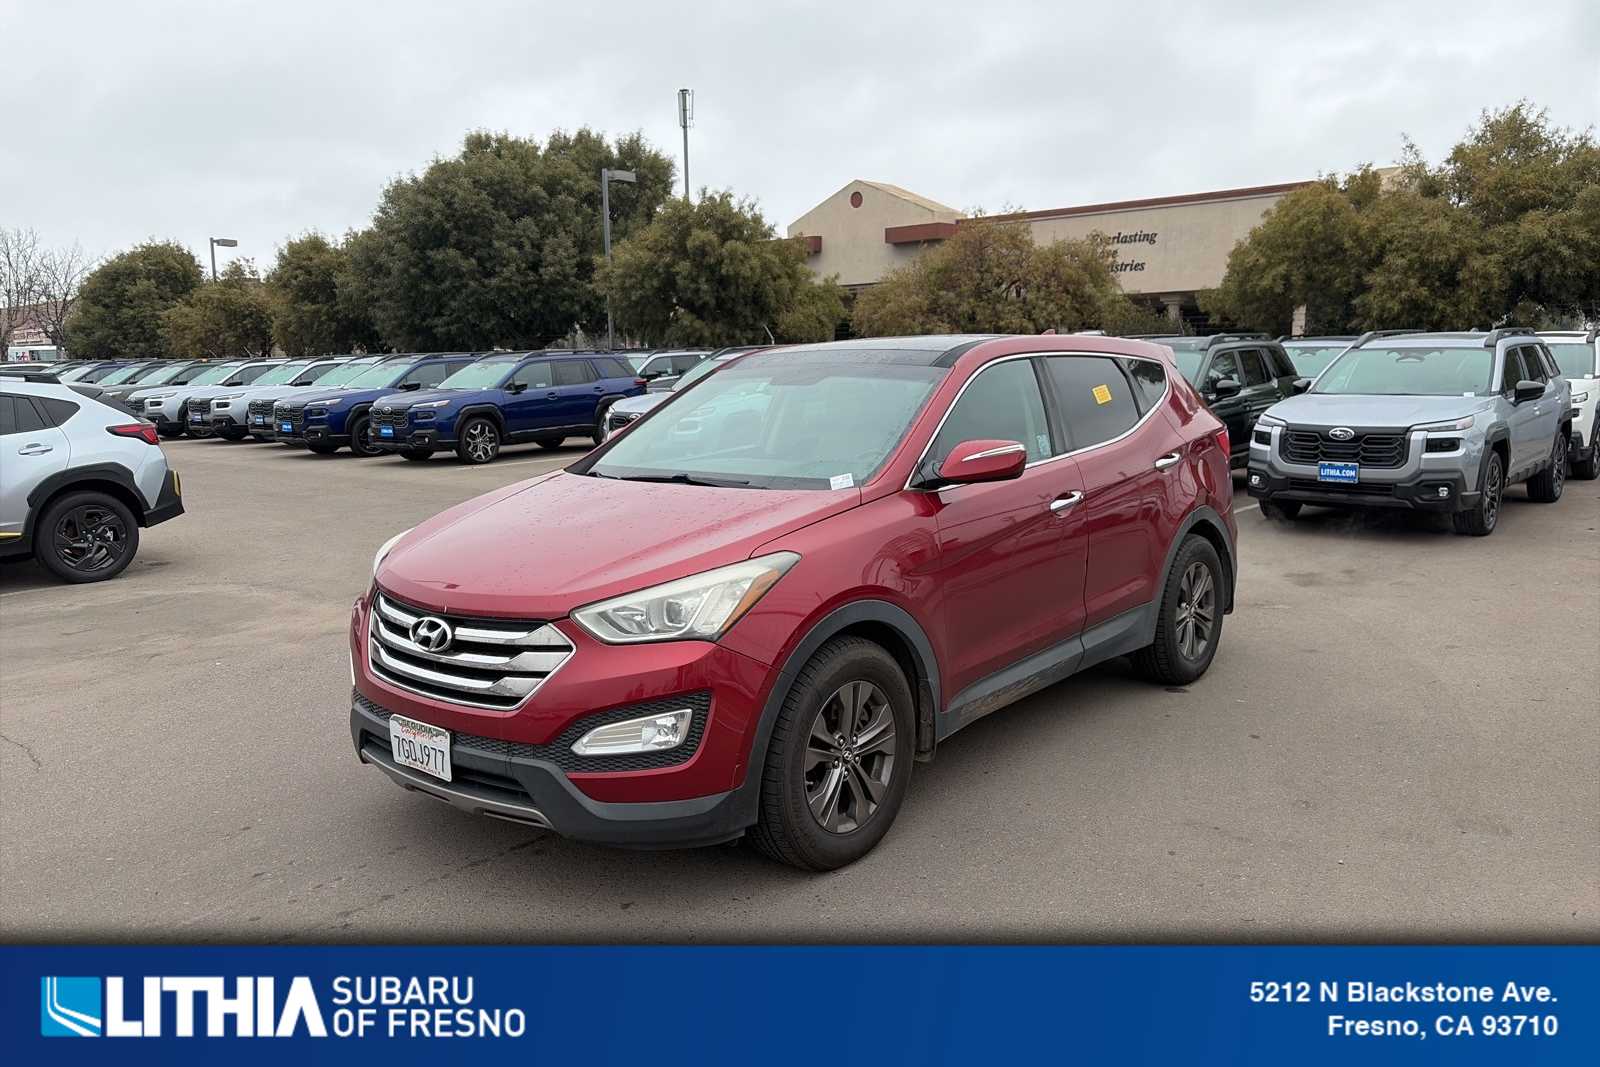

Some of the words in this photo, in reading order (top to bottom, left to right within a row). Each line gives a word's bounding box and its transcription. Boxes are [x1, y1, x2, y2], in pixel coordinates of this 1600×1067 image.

[1092, 230, 1158, 245] erlasting
[1106, 260, 1146, 273] istries
[1320, 468, 1356, 477] LITHIA.COM
